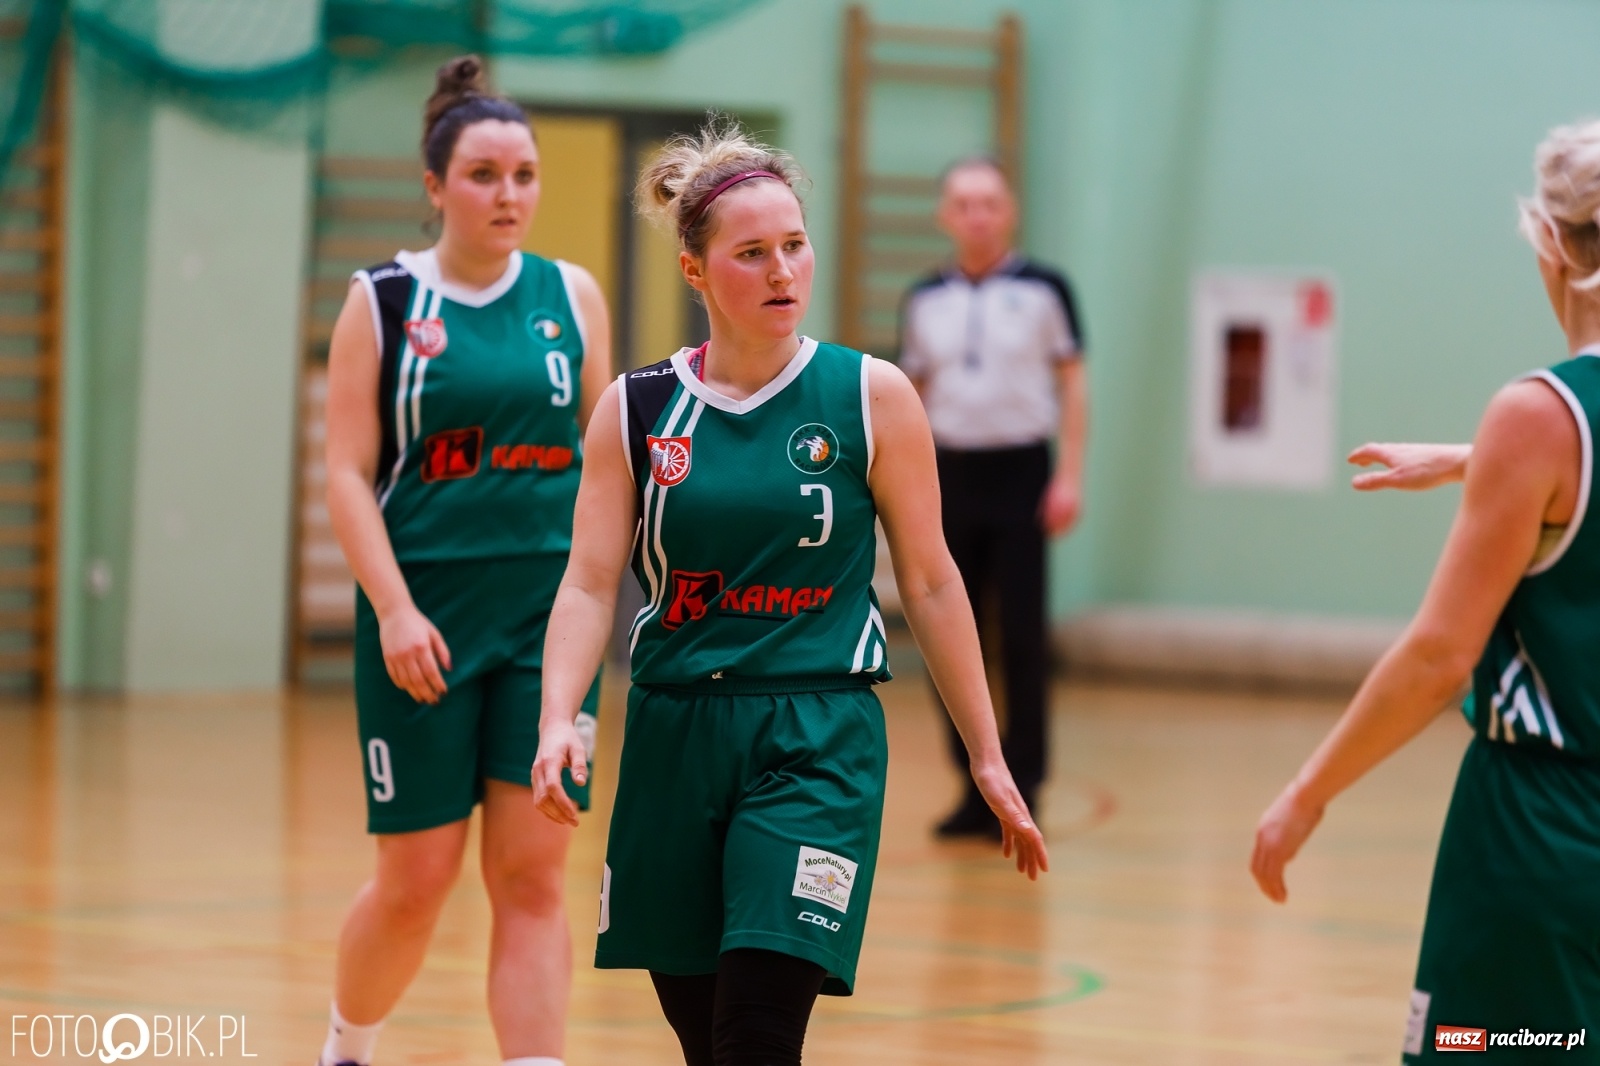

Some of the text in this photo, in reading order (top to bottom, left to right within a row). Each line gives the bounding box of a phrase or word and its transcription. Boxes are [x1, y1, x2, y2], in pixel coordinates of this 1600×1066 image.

[546, 350, 572, 407] 9
[630, 367, 674, 379] COLO
[798, 484, 834, 547] 3
[368, 738, 395, 802] 9
[799, 881, 827, 896] Marcin
[797, 911, 841, 932] COLO
